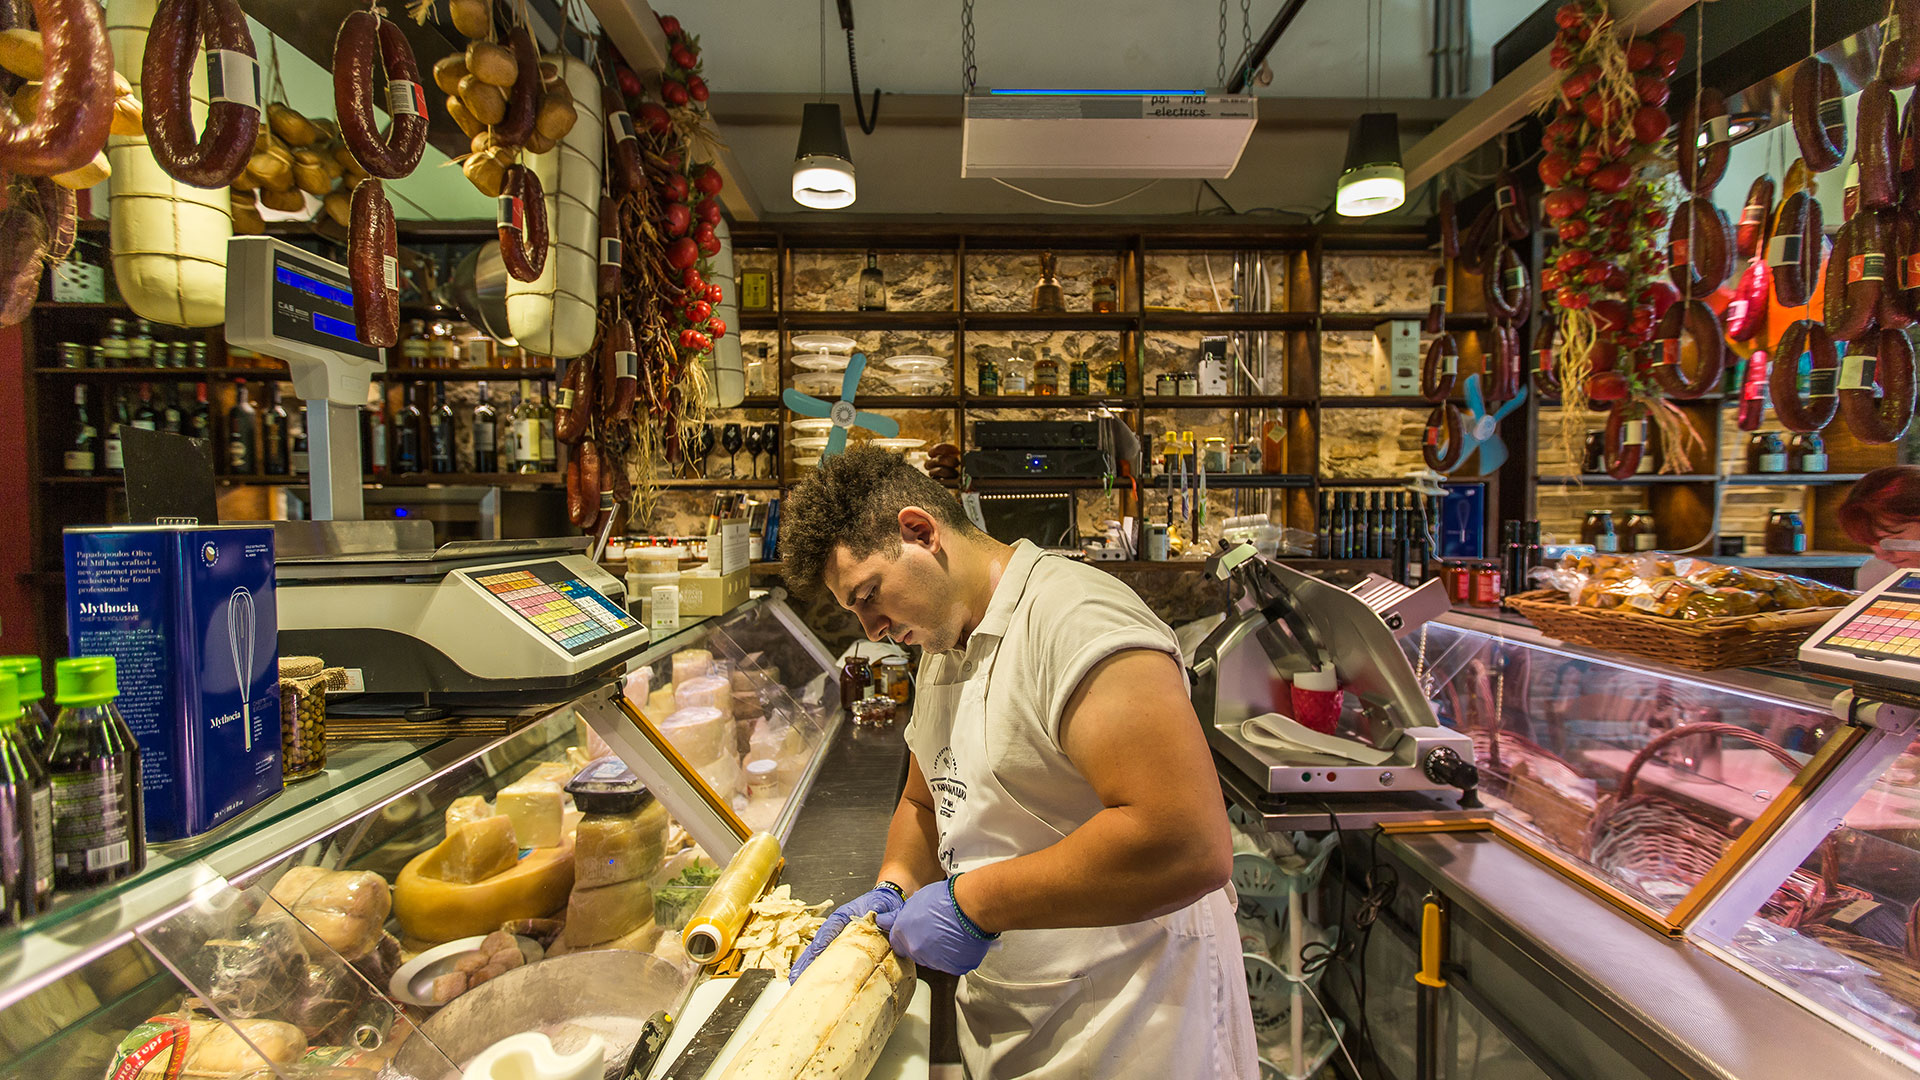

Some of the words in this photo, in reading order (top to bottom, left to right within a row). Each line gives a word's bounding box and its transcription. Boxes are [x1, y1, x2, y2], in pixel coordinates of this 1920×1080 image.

[1154, 106, 1206, 117] electrics
[277, 301, 295, 312] CAS
[76, 550, 130, 559] Papadopoulos
[131, 549, 153, 557] Olive
[77, 559, 88, 567] Oil
[90, 559, 105, 567] Mill
[121, 558, 150, 566] crafted
[95, 568, 128, 577] gourmet
[129, 567, 161, 576] product
[78, 576, 117, 585] exclusively
[78, 585, 129, 595] professionals:
[80, 602, 139, 616] Mythocia
[210, 710, 241, 729] Mythocia
